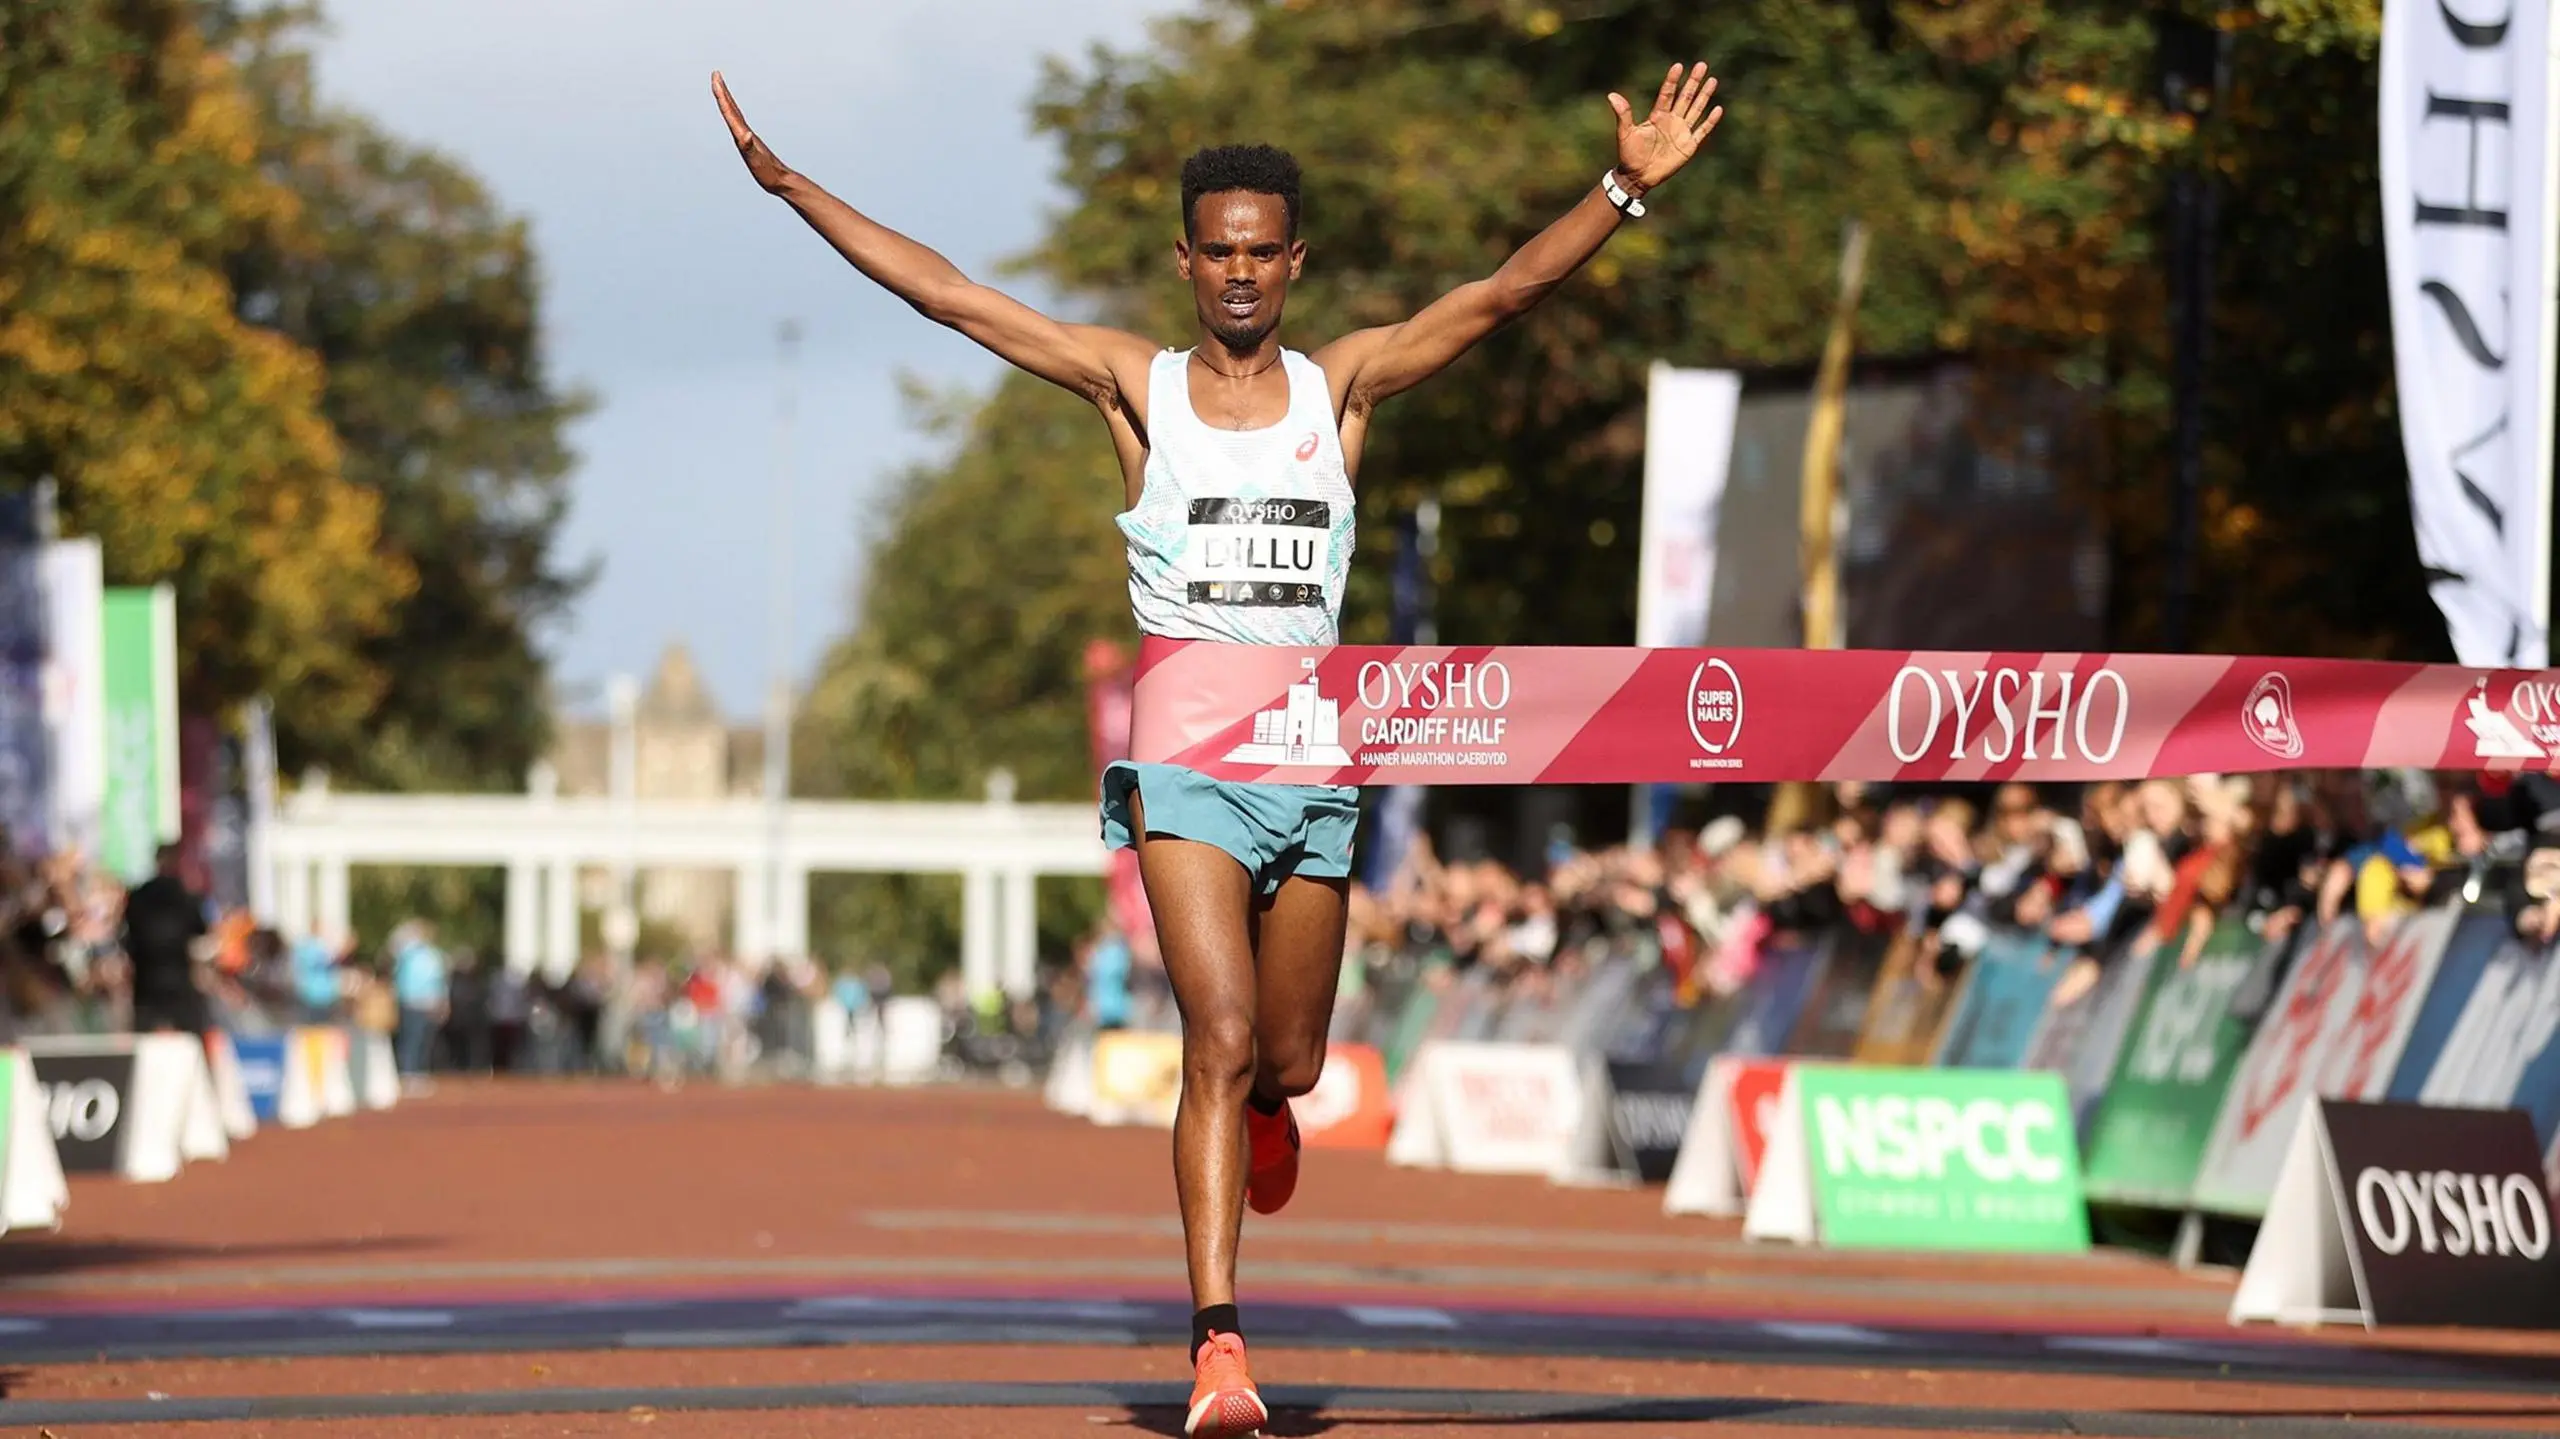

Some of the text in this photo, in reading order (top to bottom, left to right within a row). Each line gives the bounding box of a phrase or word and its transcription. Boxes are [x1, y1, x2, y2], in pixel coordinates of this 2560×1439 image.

[1229, 503, 1296, 521] OYSHO
[1205, 536, 1314, 571] DILLU
[1356, 660, 1512, 711] OYSHO
[1697, 689, 1734, 706] SUPER
[1697, 706, 1734, 722] HALFS
[1886, 664, 2129, 764] OYSHO
[1361, 717, 1507, 745] CARDIFF HALF
[1360, 752, 1508, 766] HANNER MARATHON CAERDYDD
[1815, 1092, 2062, 1183] NSPCC
[2356, 1166, 2551, 1261] OYSHO
